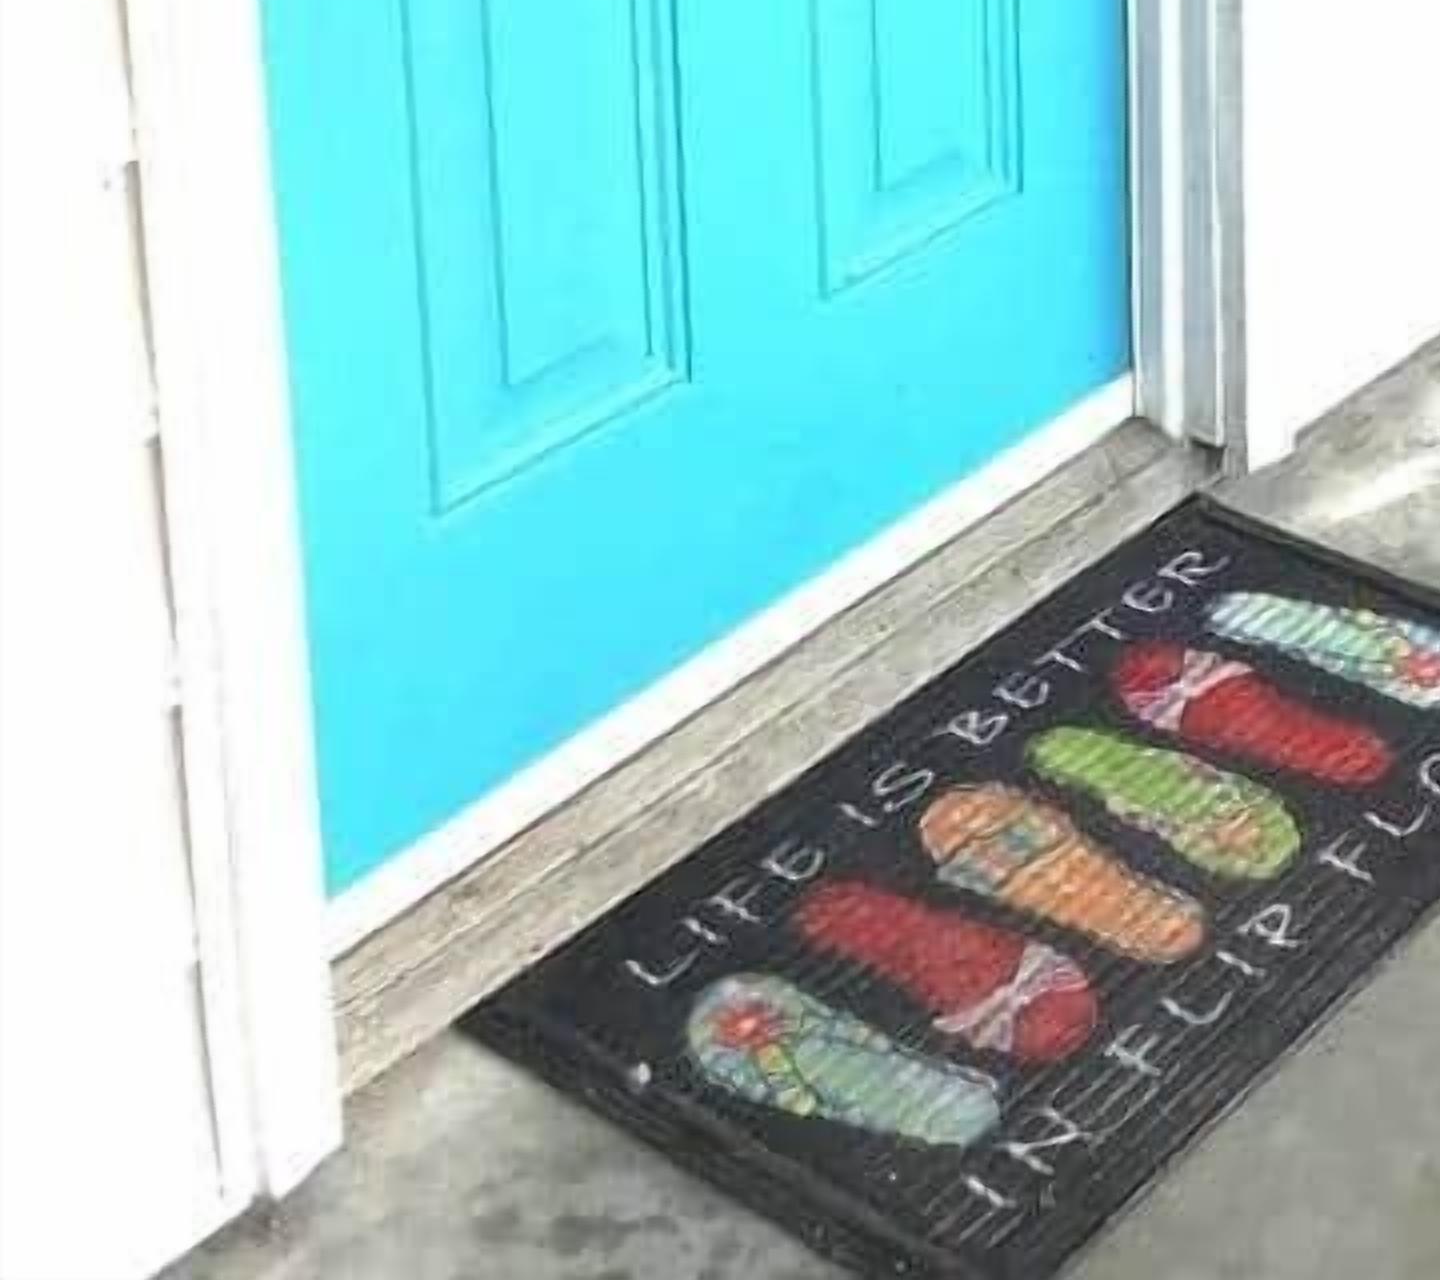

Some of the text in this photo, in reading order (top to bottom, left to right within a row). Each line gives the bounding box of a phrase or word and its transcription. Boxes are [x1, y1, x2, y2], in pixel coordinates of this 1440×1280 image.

[623, 548, 1232, 988] LIFE IS BETTER
[962, 1092, 1098, 1212] IN
[1101, 901, 1299, 1077] FLIP
